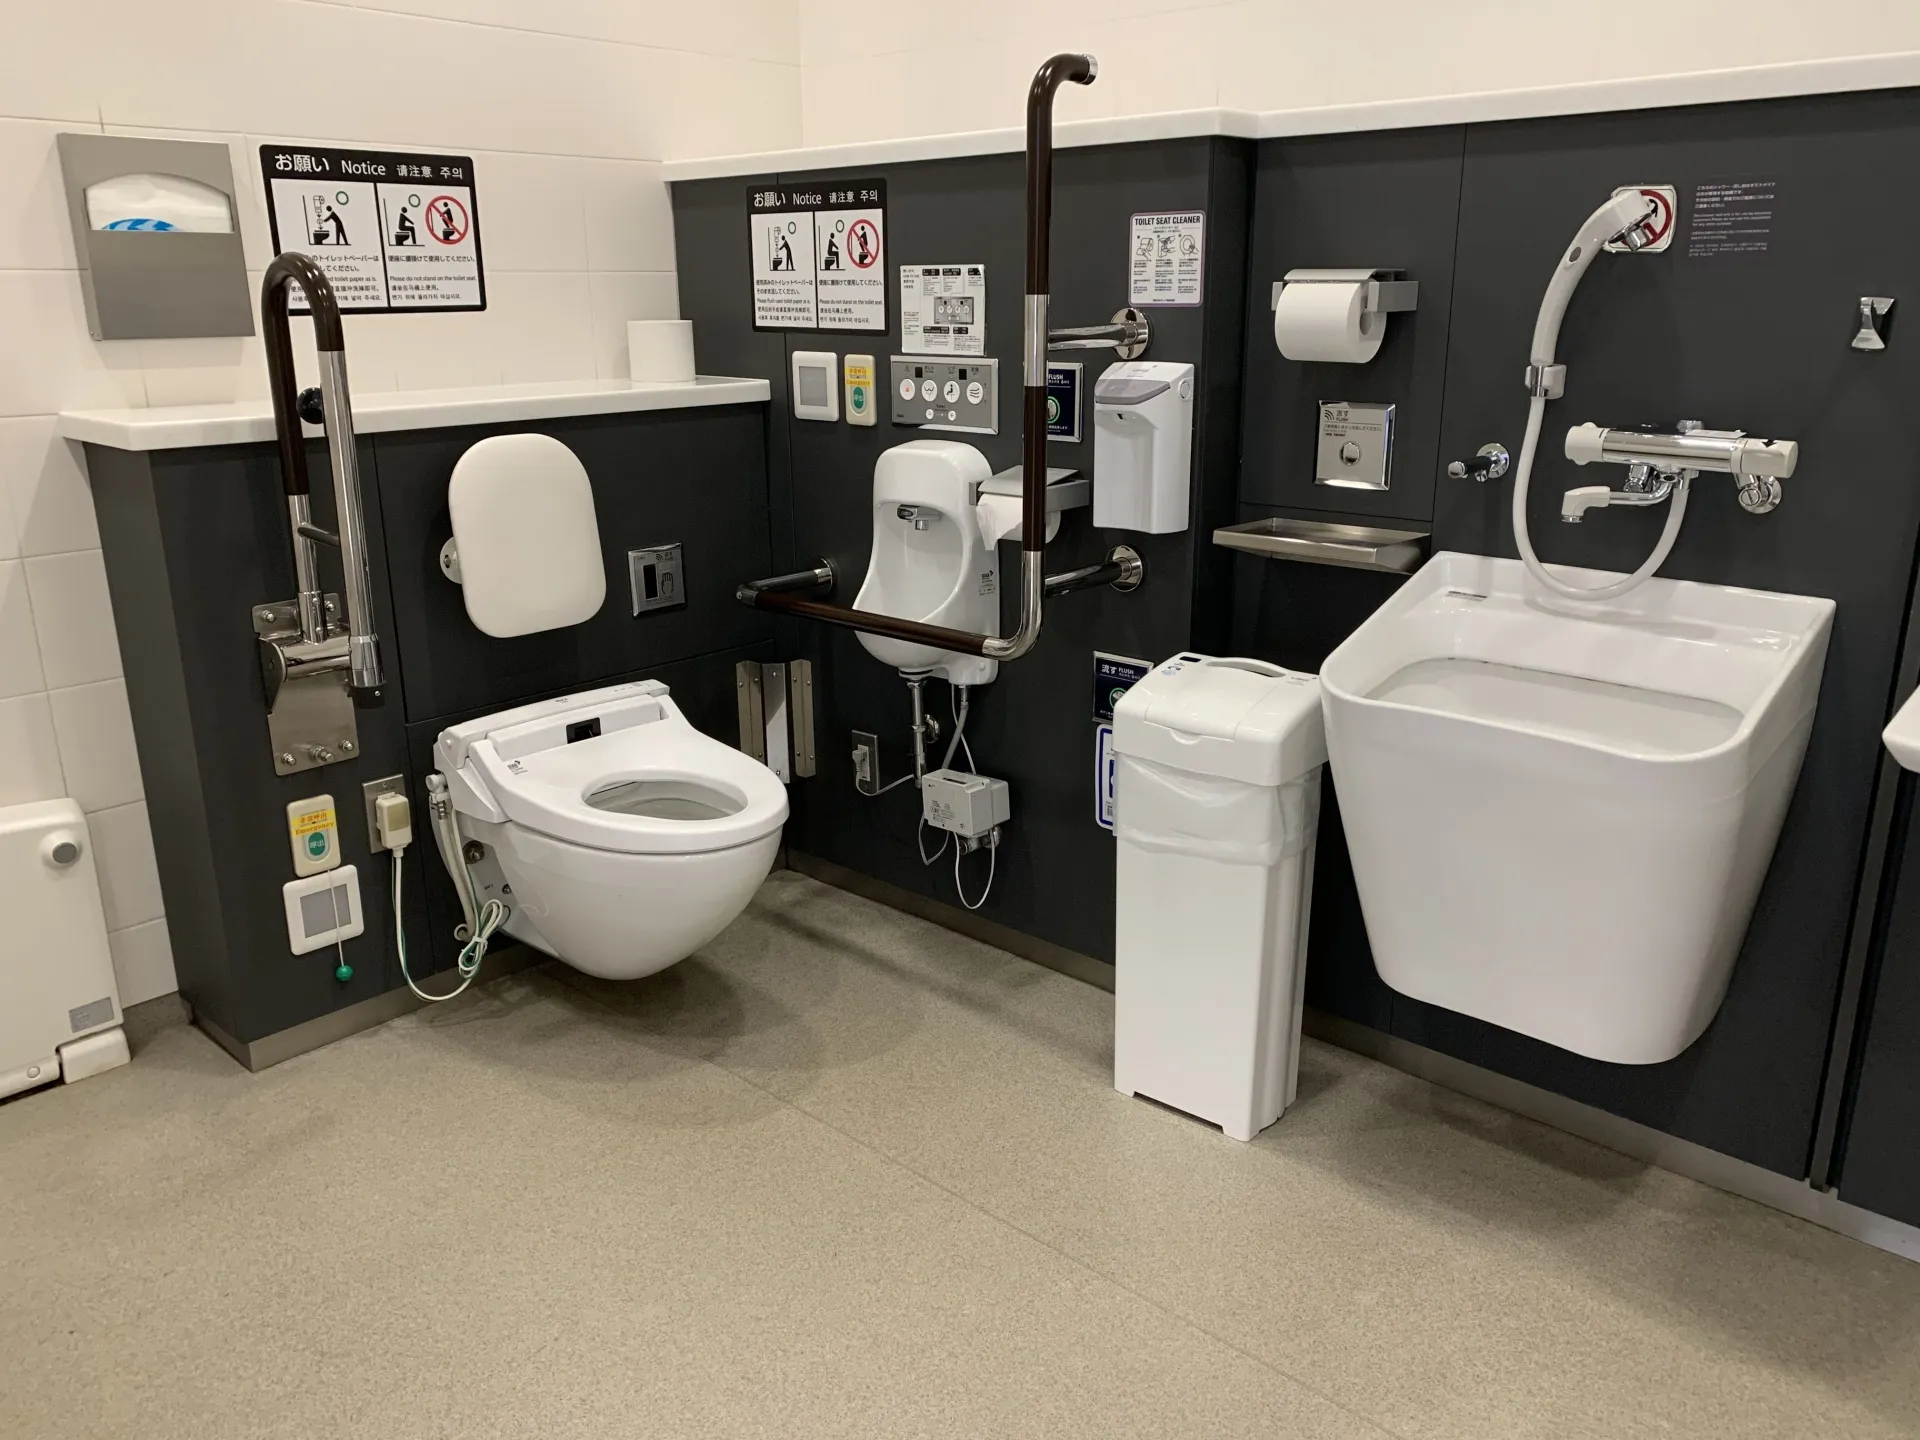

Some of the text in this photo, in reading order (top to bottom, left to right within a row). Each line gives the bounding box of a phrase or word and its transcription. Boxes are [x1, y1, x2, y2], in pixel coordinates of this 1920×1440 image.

[275, 154, 463, 179] お願い Notice 请注意 주의
[754, 189, 878, 207] お願い Notice 请注意 주의
[1135, 215, 1201, 226] TOILET SEAT CLEANER
[1101, 664, 1134, 675] 流す FLUSH
[295, 821, 335, 836] Emergency
